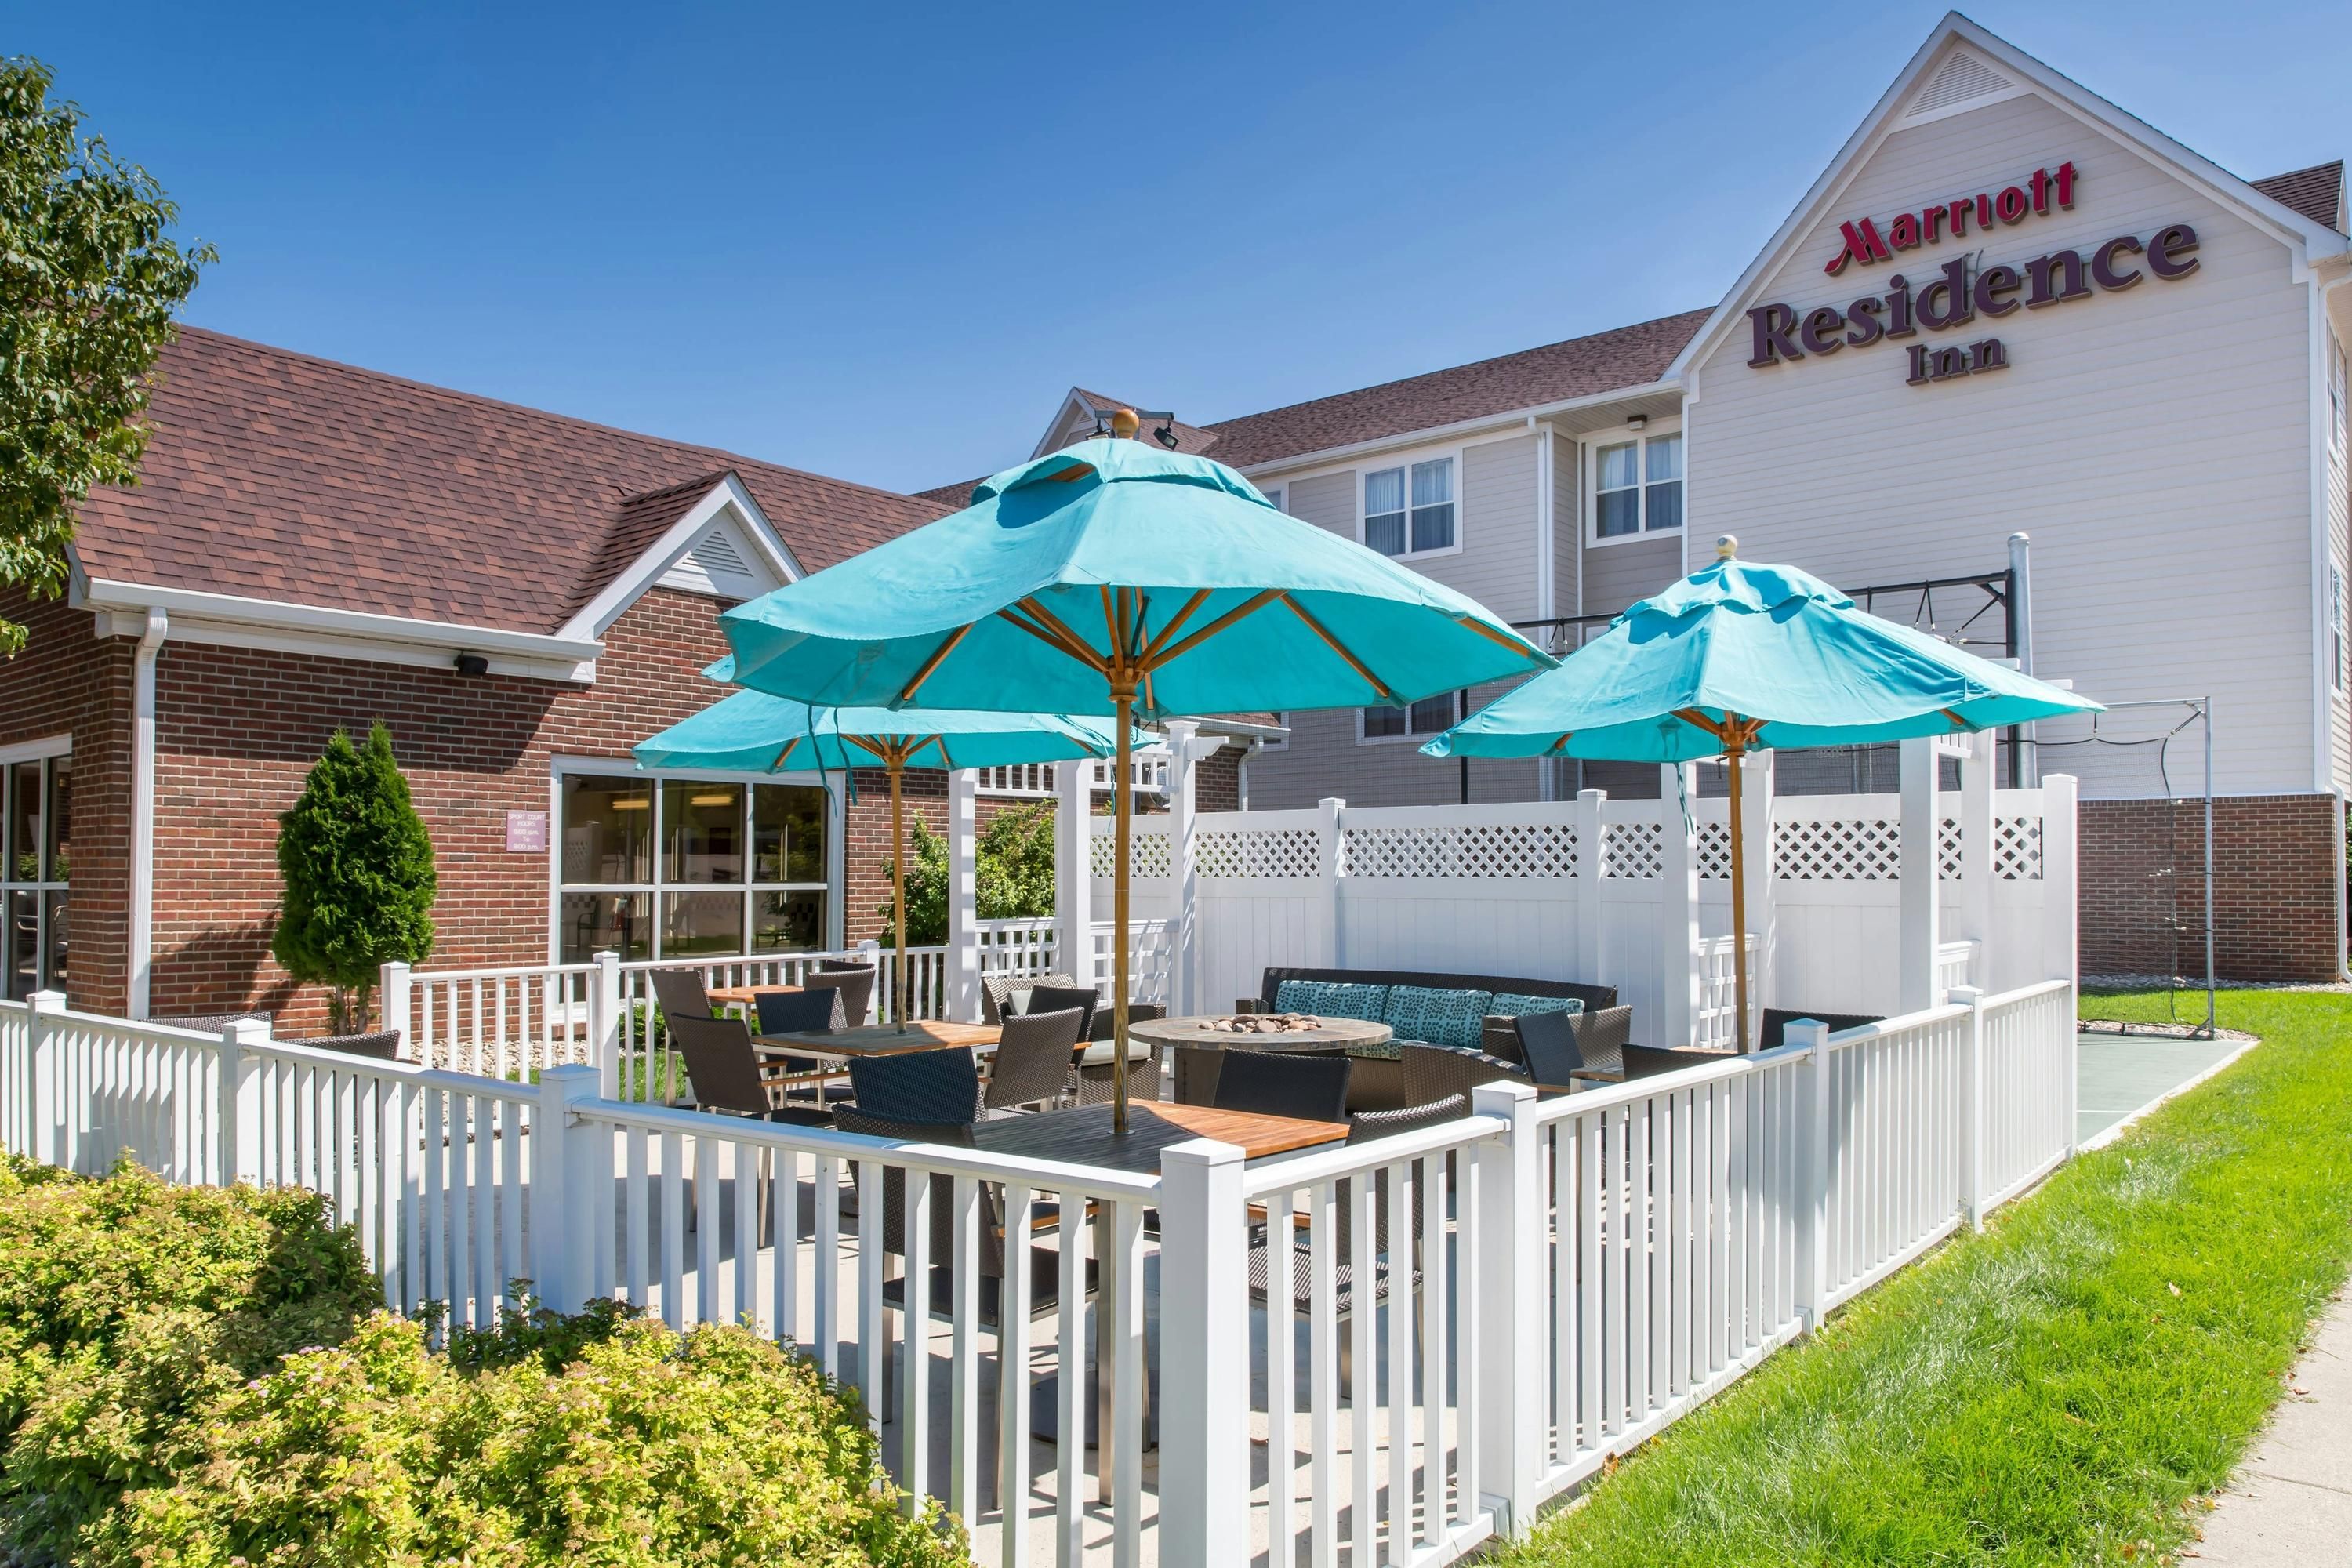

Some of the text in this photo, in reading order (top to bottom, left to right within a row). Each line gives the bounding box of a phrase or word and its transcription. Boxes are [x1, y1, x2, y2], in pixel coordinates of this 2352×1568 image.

[1824, 160, 2079, 276] Marriott
[1746, 223, 2200, 369] Residence
[1905, 336, 2009, 387] Inn
